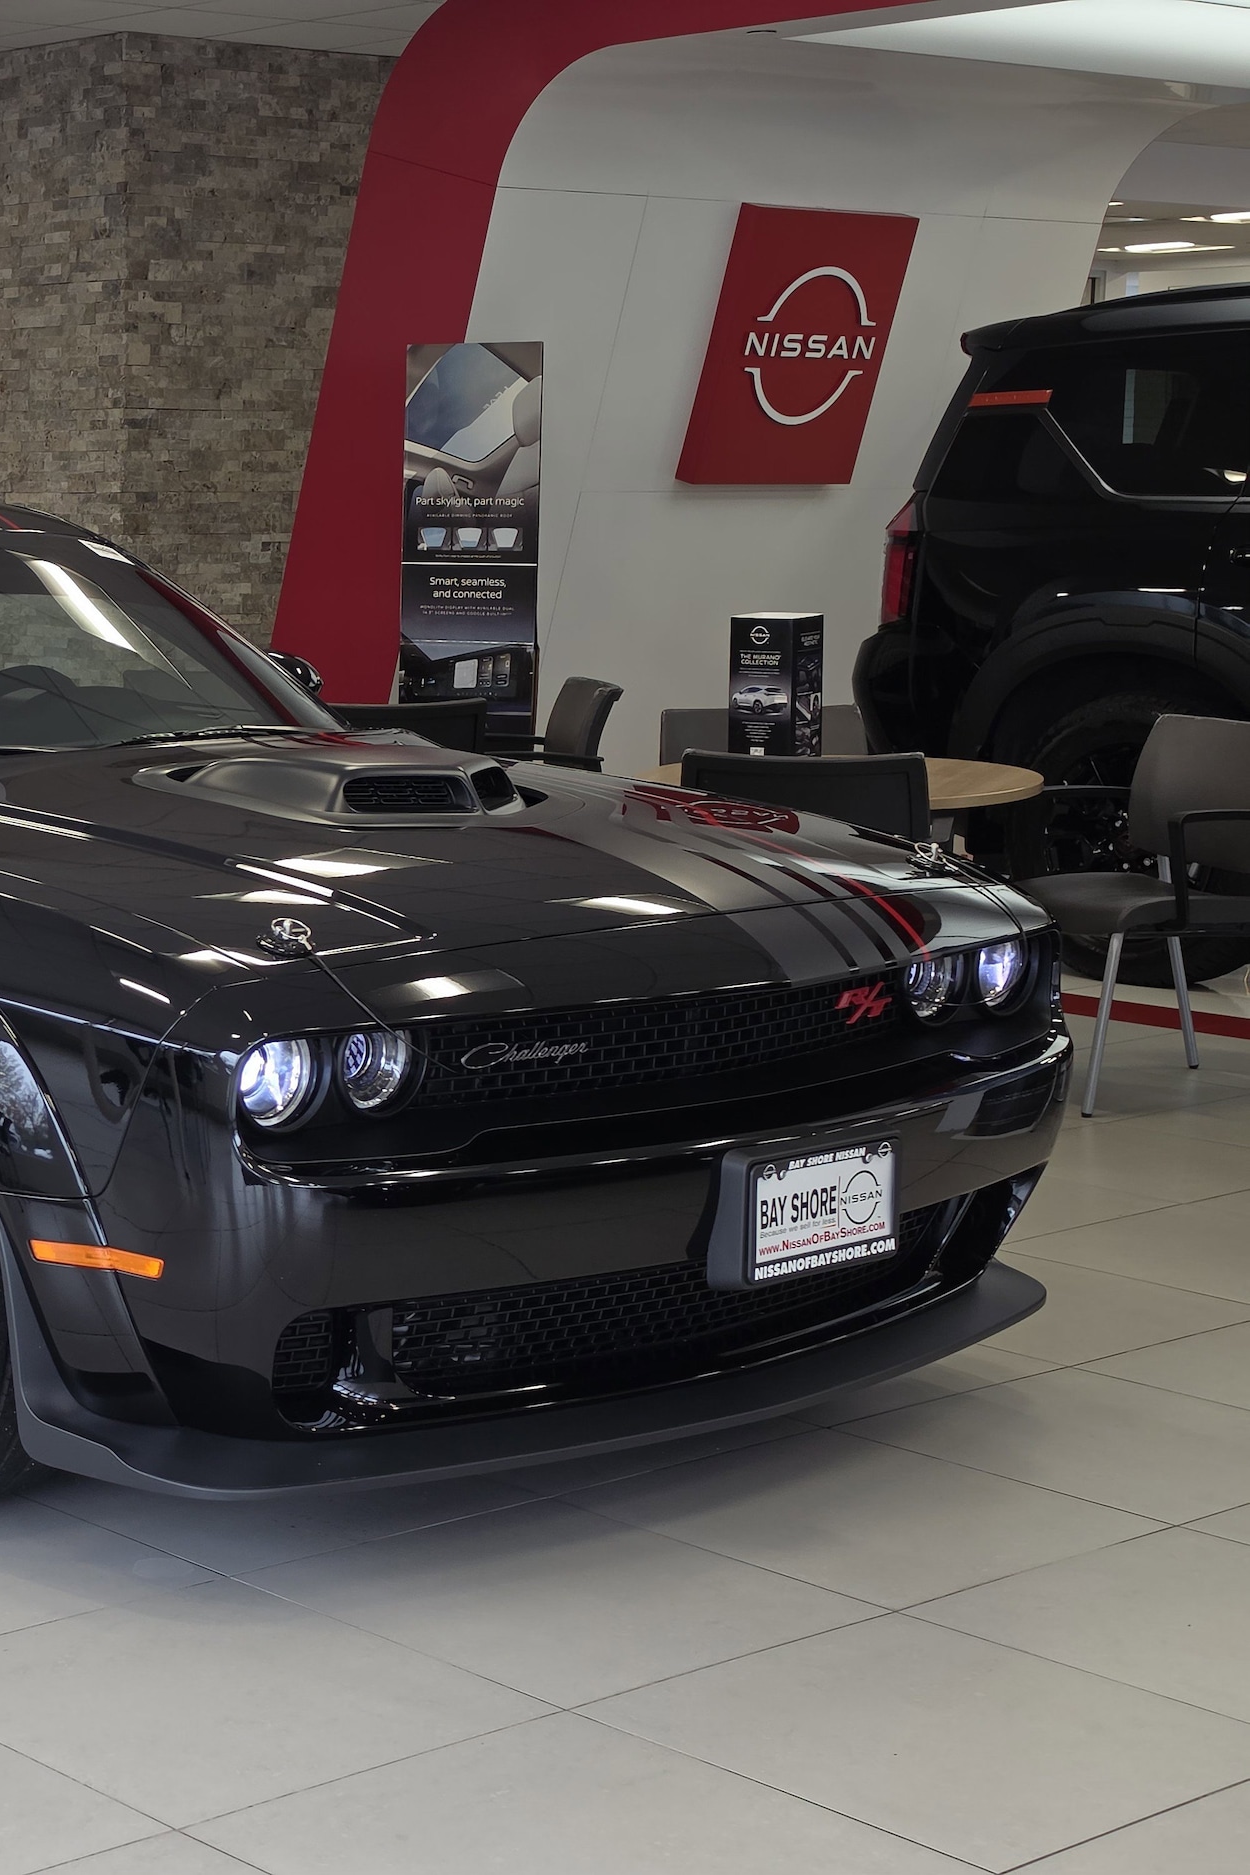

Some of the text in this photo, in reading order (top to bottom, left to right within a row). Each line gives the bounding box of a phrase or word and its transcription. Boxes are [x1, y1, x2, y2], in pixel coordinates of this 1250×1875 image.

[744, 332, 876, 359] NISSAN
[415, 497, 525, 507] Part skylight, part magic
[429, 577, 507, 587] Smart, seamless,
[433, 590, 502, 599] and connected
[834, 981, 892, 1024] R/T
[461, 1041, 589, 1069] Challenger
[788, 1147, 866, 1170] BAY SHORE NISSAN
[760, 1186, 837, 1230] BAY SHORE
[840, 1189, 883, 1206] NISSAN
[760, 1228, 787, 1239] Because
[800, 1221, 811, 1230] sell
[812, 1219, 821, 1227] for
[754, 1238, 896, 1280] NISSANOFBAYSHORE.COM
